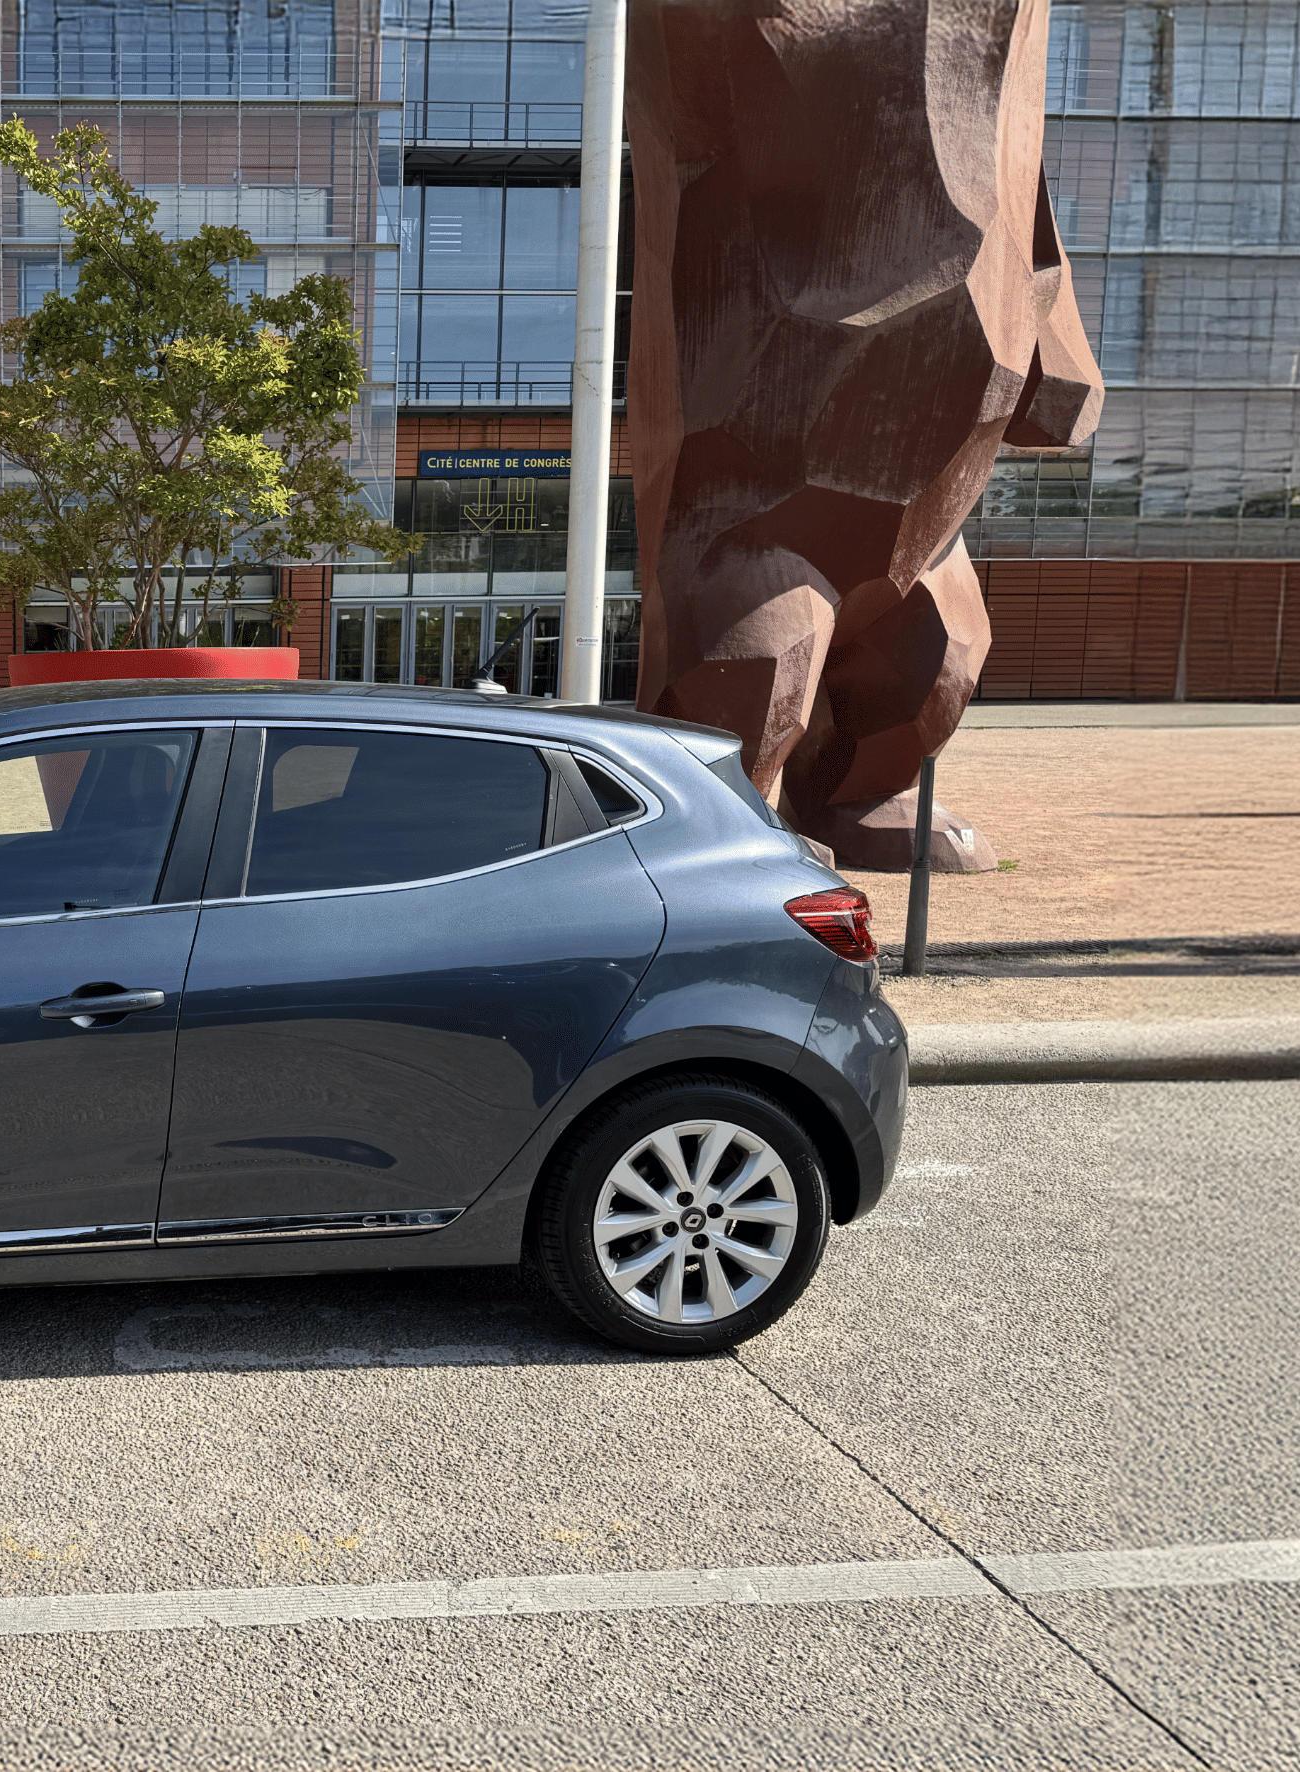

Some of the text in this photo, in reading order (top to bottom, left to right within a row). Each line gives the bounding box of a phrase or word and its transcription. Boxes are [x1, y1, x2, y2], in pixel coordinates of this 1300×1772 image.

[459, 458, 500, 468] CENTRE
[505, 458, 519, 468] DE
[523, 455, 572, 468] CONGRÈS
[361, 1212, 435, 1228] CLIO
